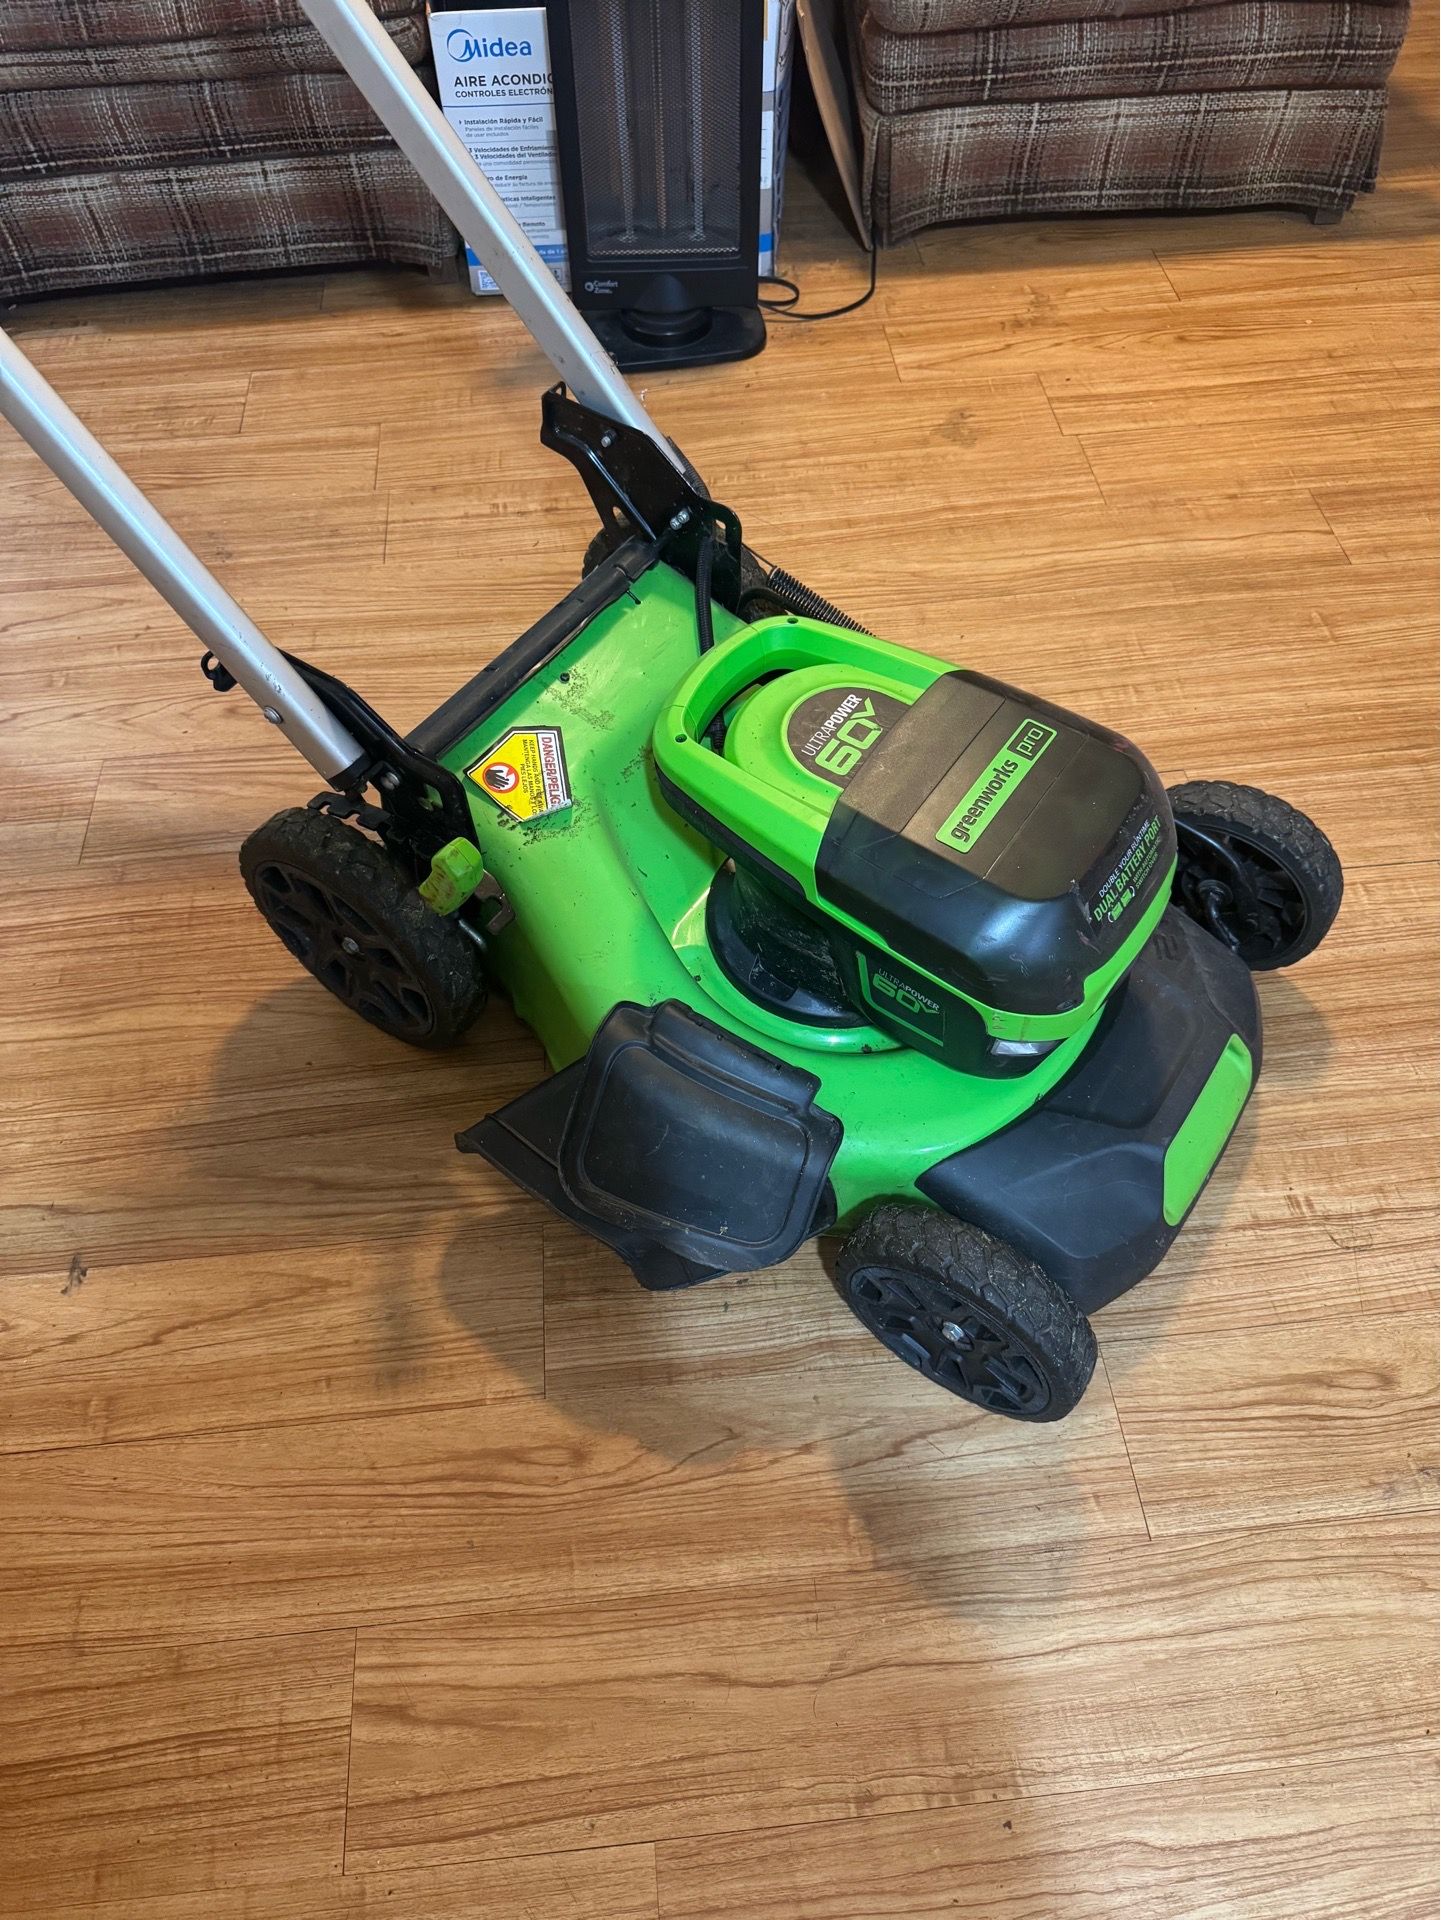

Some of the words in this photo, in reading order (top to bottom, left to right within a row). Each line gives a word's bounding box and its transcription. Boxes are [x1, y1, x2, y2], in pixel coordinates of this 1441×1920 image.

[454, 34, 532, 61] Midea
[454, 75, 487, 87] AIRE
[455, 89, 506, 98] CONTROLES
[499, 117, 521, 125] Rápida
[593, 280, 619, 288] Comfort
[801, 693, 862, 756] ULTRAPOWER
[523, 739, 531, 769] MANTENGA
[541, 736, 561, 806] DANGER/PELIG
[951, 759, 1018, 842] greenworks
[1016, 728, 1043, 756] pro
[1093, 888, 1119, 922] DUAL
[1115, 842, 1147, 892] BATTERY
[1144, 814, 1161, 846] PORT
[1099, 870, 1120, 898] DOUBLE
[1118, 849, 1132, 869] YOUR
[1131, 819, 1150, 853] RUNTIME
[879, 968, 940, 1011] ULTRAPOWER
